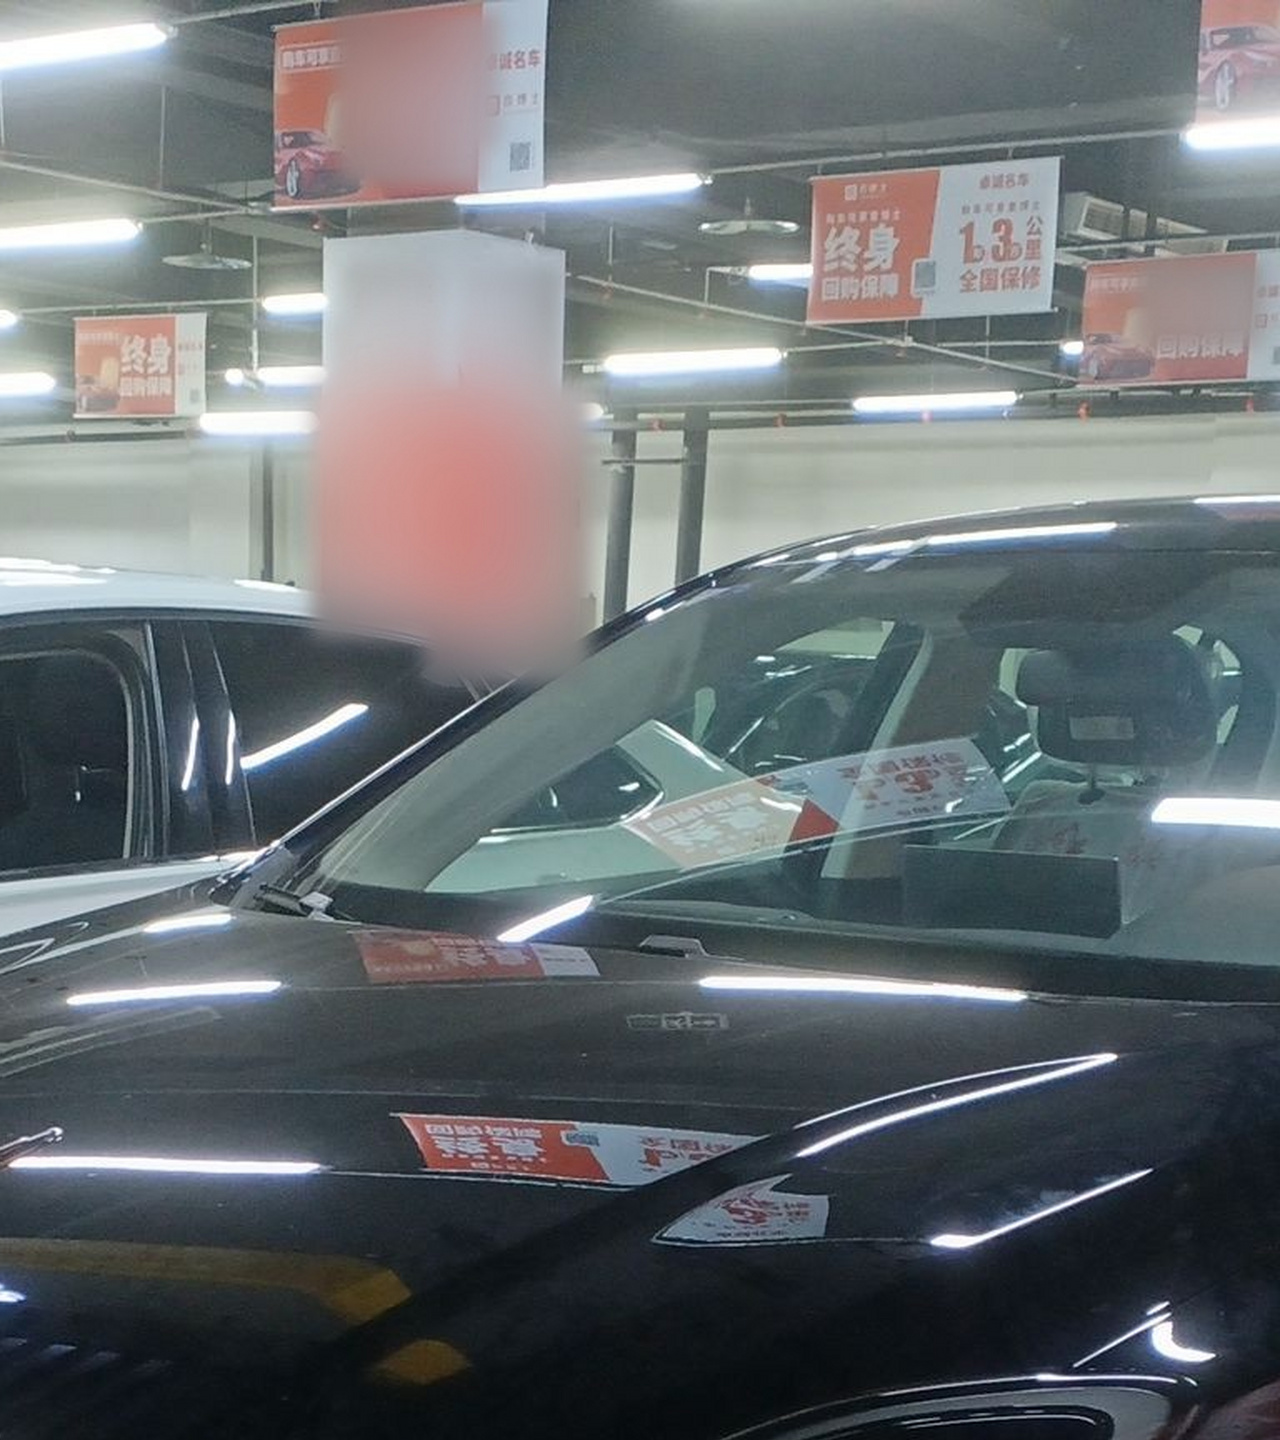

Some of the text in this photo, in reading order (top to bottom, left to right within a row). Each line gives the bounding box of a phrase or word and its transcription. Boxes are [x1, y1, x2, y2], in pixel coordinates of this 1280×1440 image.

[824, 223, 900, 273] 终身
[822, 273, 900, 300] 回购保障
[959, 265, 1041, 293] 全国保修
[120, 333, 172, 374] 终身
